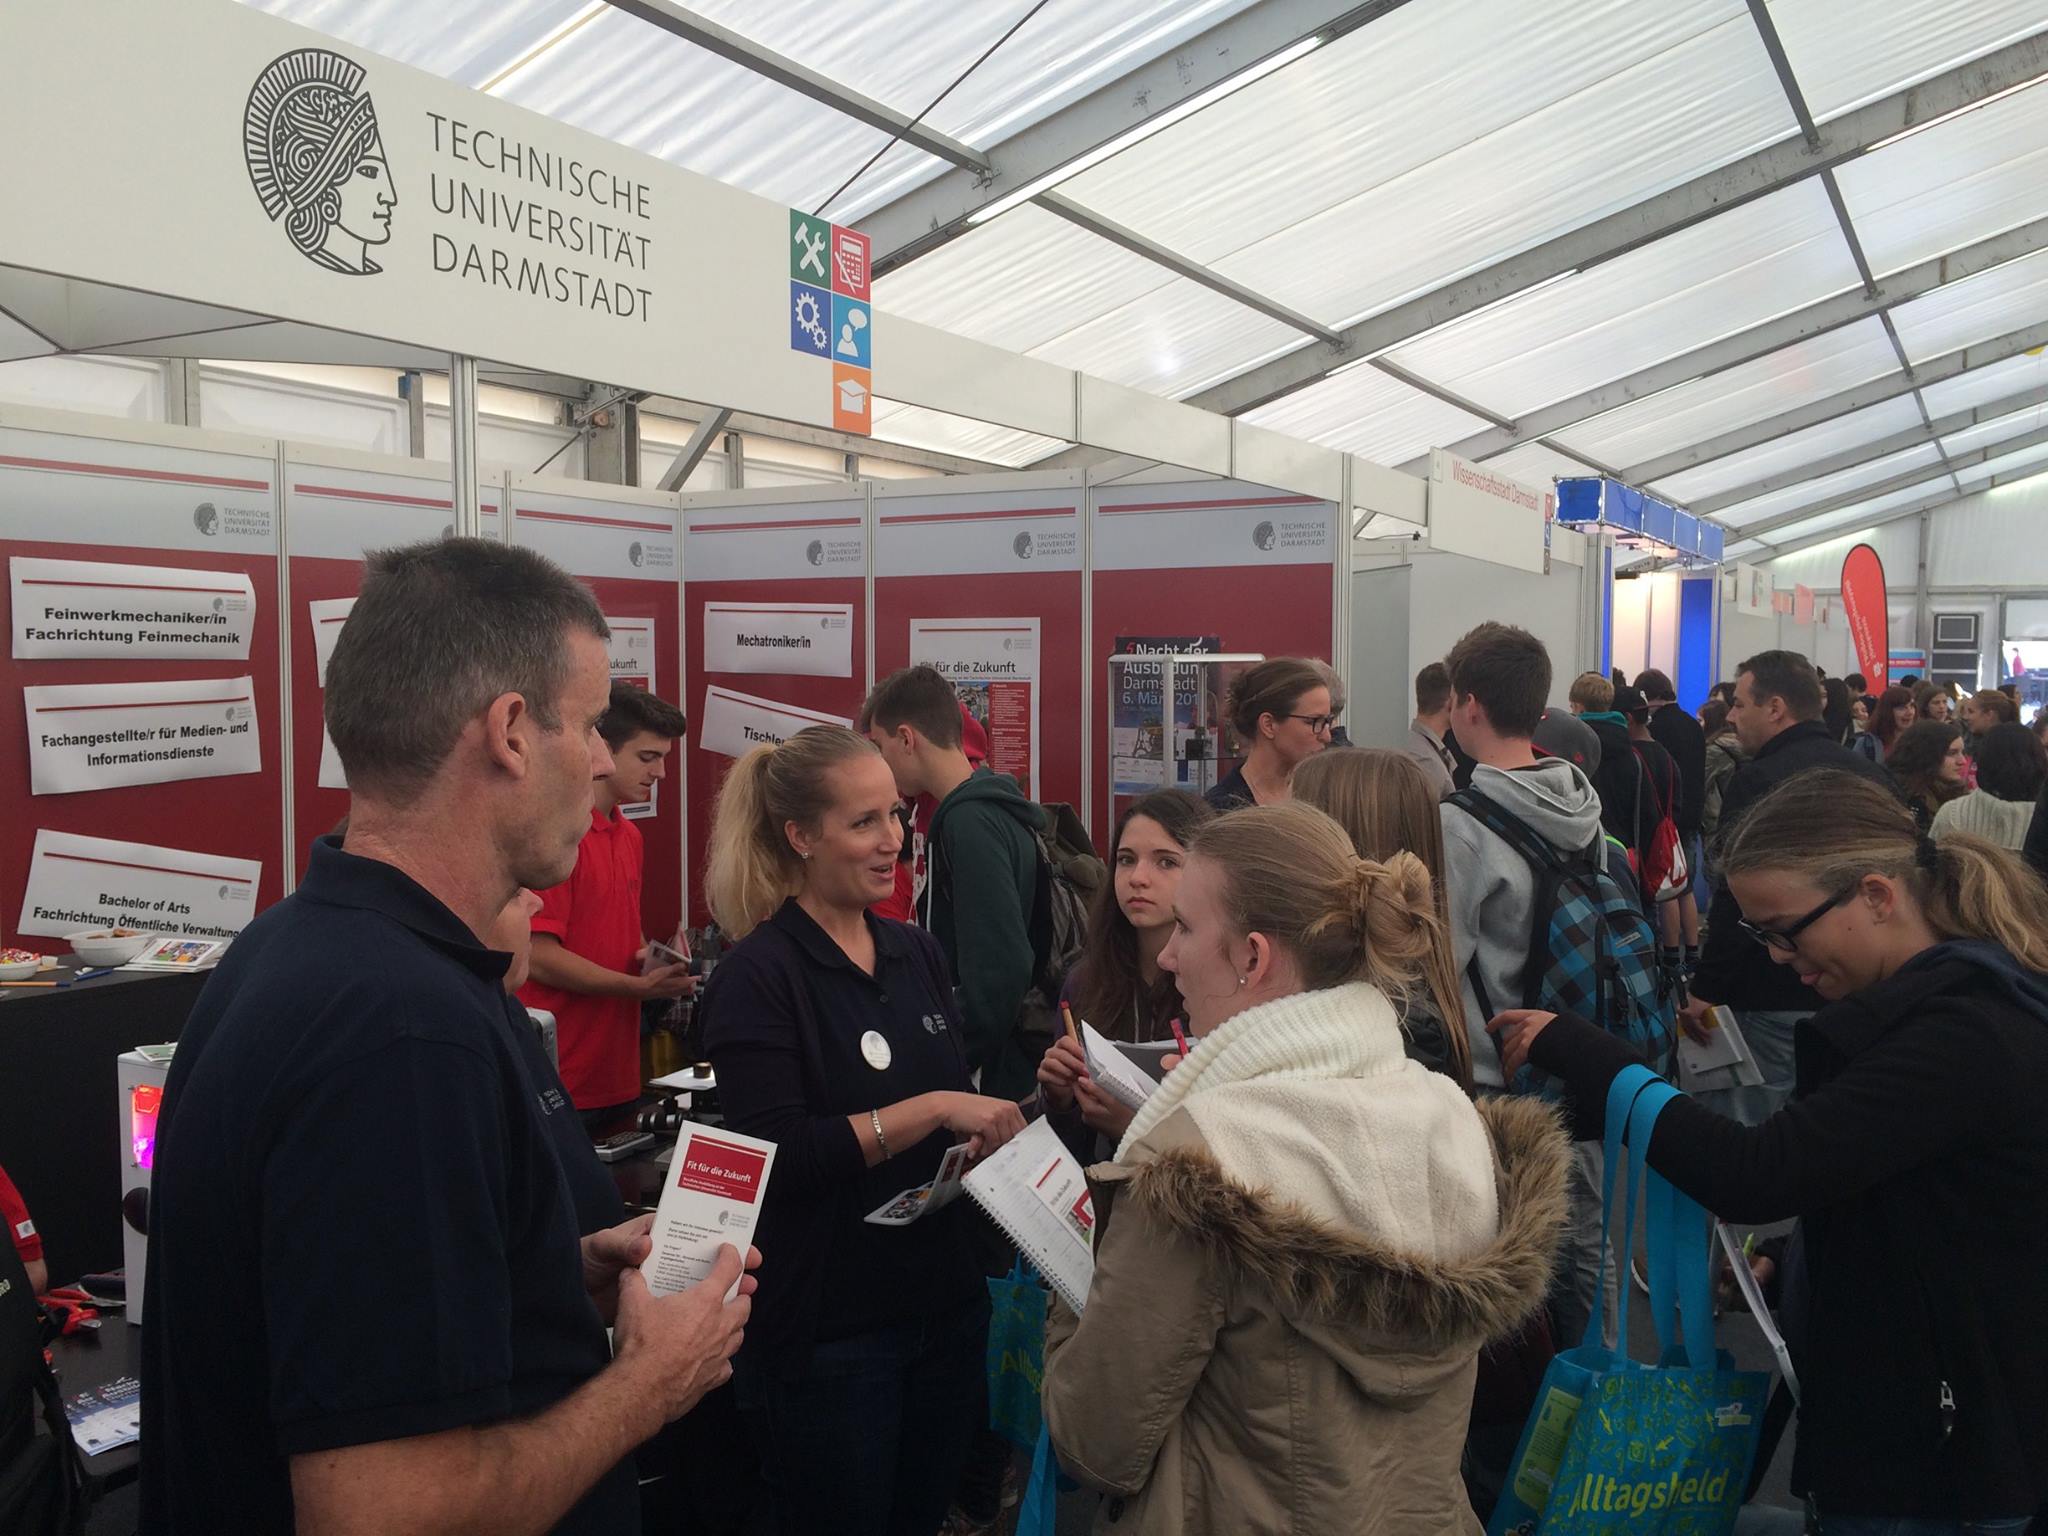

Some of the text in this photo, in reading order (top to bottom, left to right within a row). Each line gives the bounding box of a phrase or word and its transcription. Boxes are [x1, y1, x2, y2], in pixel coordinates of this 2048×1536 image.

[426, 112, 650, 220] TECHNISCHE
[431, 173, 651, 270] UNIVERSITÄT
[433, 233, 652, 322] DARMSTADT
[44, 607, 227, 625] Feinwerkmechaniker/in
[25, 628, 240, 644] Fachrichtung Feinmechanik
[737, 633, 811, 648] Mechatroniker/in
[610, 658, 637, 669] ukunft
[935, 661, 950, 673] für
[953, 661, 970, 673] die
[973, 661, 1016, 673] Zukunft
[41, 721, 249, 748] Fachangestellte/r für Medien- und
[87, 745, 215, 766] Informationsdienste
[98, 893, 191, 915] Bachelor of Arts
[33, 906, 115, 929] Fachrichtung
[118, 913, 179, 933] Öffentliche
[687, 1160, 697, 1171] Fit
[698, 1162, 710, 1173] für
[711, 1165, 723, 1177] die
[723, 1168, 752, 1184] Zukunft
